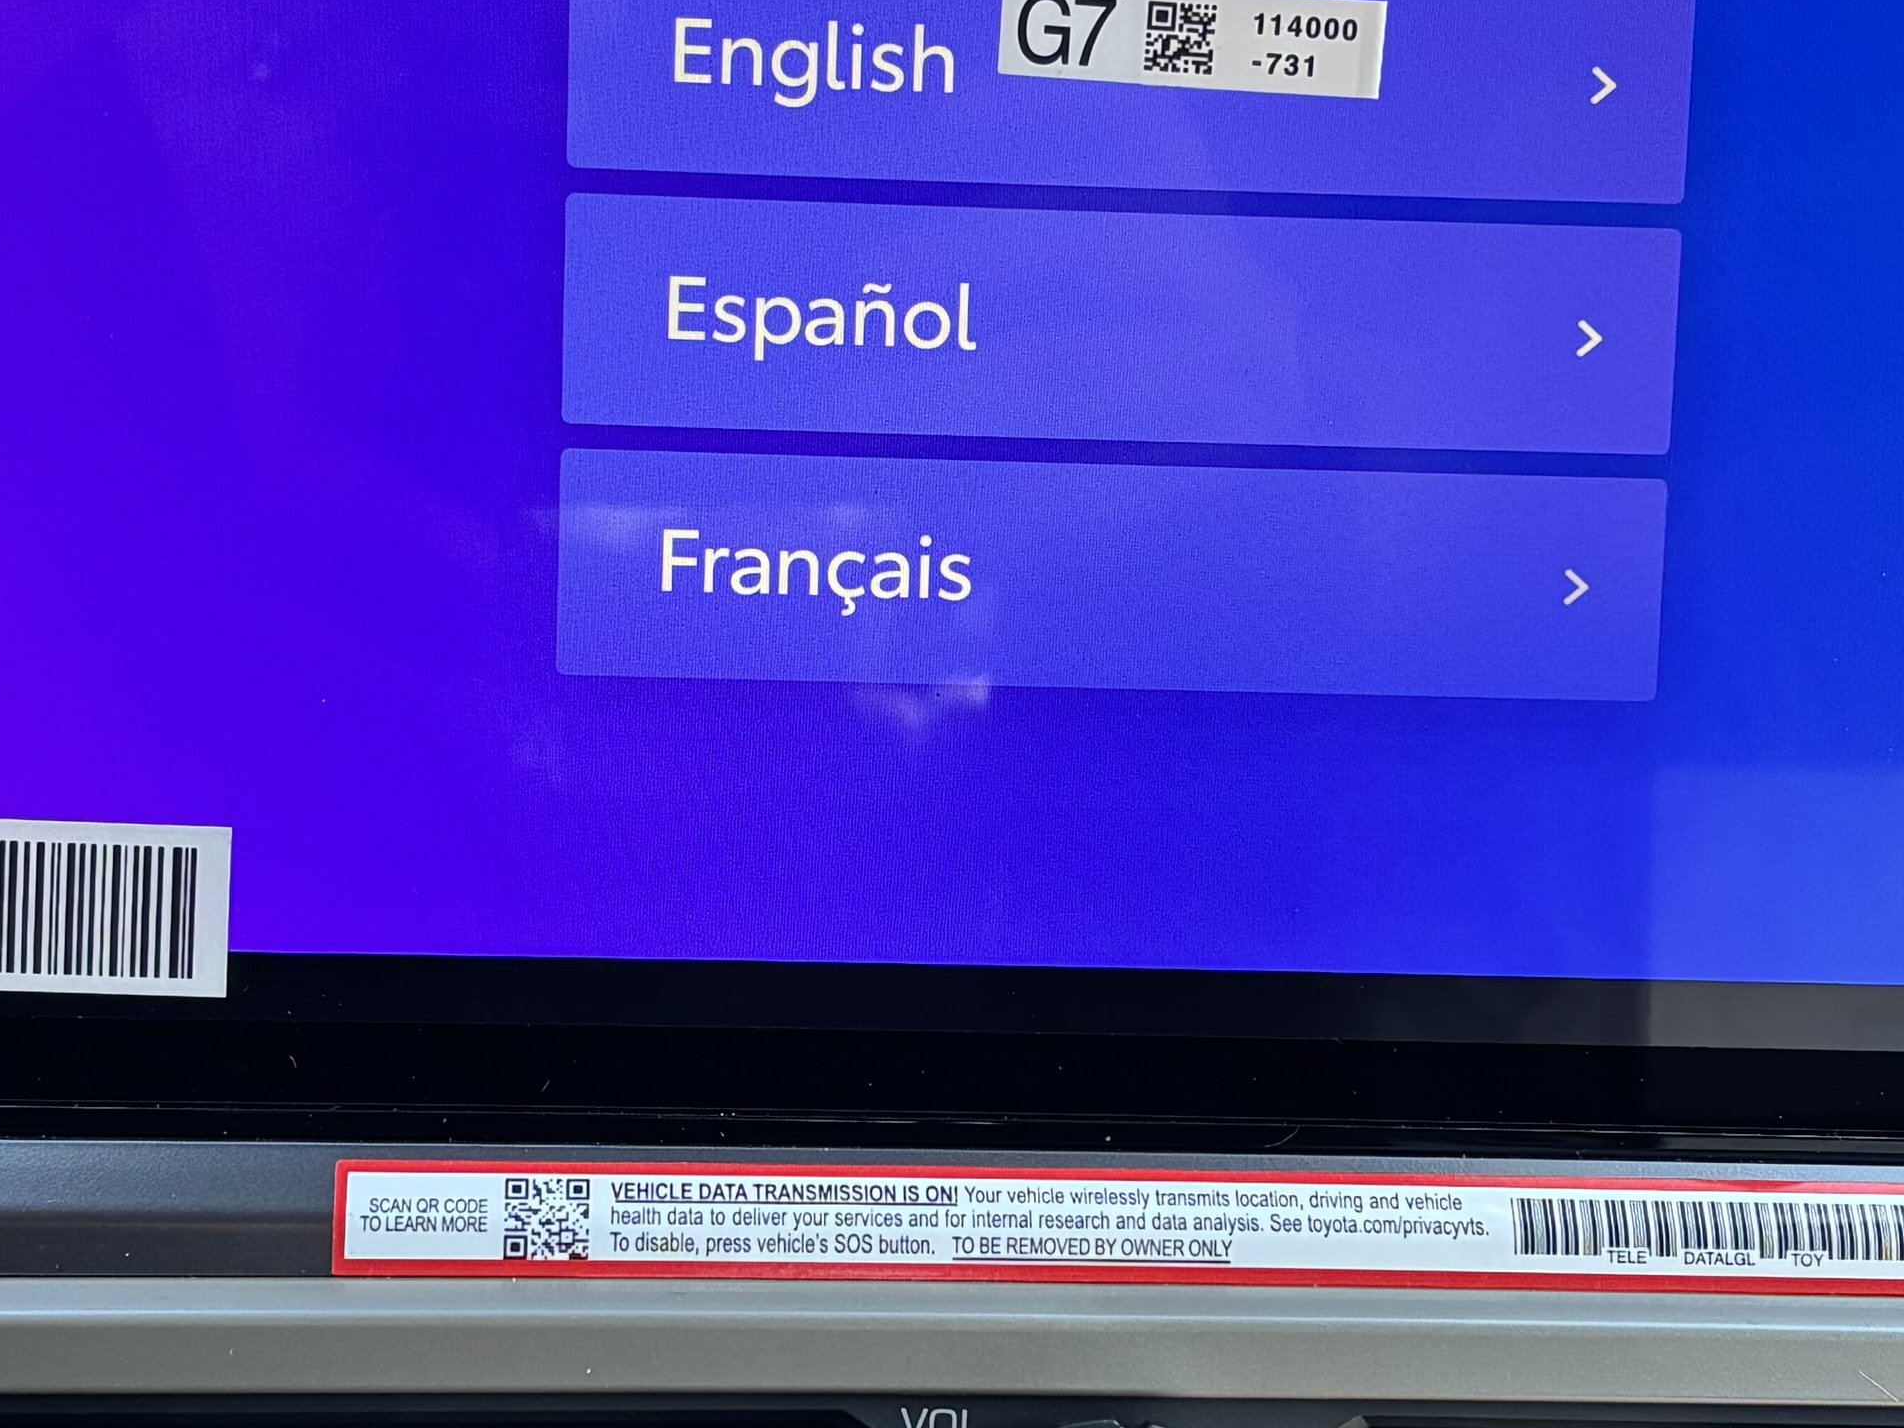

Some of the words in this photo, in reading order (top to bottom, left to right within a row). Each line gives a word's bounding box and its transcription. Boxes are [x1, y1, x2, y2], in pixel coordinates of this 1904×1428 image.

[1254, 13, 1357, 41] 114000
[674, 18, 955, 108] English
[1252, 53, 1314, 77] -731
[668, 276, 976, 362] Español
[662, 529, 972, 617] Français
[369, 1198, 411, 1213] SCAN
[417, 1198, 439, 1213] QR
[444, 1199, 488, 1213] CODE
[610, 1182, 693, 1202] VEHICLE
[698, 1183, 748, 1202] DATA
[752, 1183, 896, 1204] TRANSMISSION
[902, 1185, 920, 1204] IS
[925, 1185, 958, 1205] ON!
[965, 1186, 1002, 1203] Your
[1007, 1187, 1064, 1204] vehicle
[1070, 1188, 1149, 1210] wirelessly
[1156, 1190, 1230, 1207] transmits
[1236, 1190, 1304, 1212] location,
[1309, 1190, 1363, 1213] driving
[1370, 1193, 1399, 1209] and
[1405, 1193, 1462, 1210] vehicle
[360, 1215, 381, 1232] TO
[386, 1216, 436, 1232] LEARN
[442, 1216, 487, 1232] MORE
[611, 1206, 661, 1225] health
[667, 1207, 703, 1225] data
[711, 1209, 725, 1225] to
[733, 1208, 787, 1226] deliver
[793, 1212, 829, 1231] your
[835, 1212, 902, 1227] services
[909, 1210, 938, 1227] and
[945, 1209, 966, 1227] for
[972, 1210, 1032, 1228] internal
[1039, 1211, 1109, 1229] research
[1116, 1212, 1145, 1230] and
[1152, 1212, 1187, 1230] data
[1194, 1213, 1263, 1236] analysis.
[1271, 1214, 1302, 1232] See
[610, 1232, 629, 1252] To
[635, 1232, 698, 1255] disable,
[706, 1238, 751, 1257] press
[757, 1233, 828, 1253] vehicle's
[834, 1234, 872, 1253] SOS
[879, 1234, 934, 1254] button.
[952, 1236, 974, 1254] TO
[980, 1237, 1001, 1254] BE
[1007, 1237, 1090, 1255] REMOVED
[1095, 1238, 1116, 1255] BY
[1121, 1239, 1184, 1256] OWNER
[1189, 1239, 1232, 1257] ONLY
[1607, 1250, 1647, 1264] TELE
[1791, 1253, 1823, 1267] TOY
